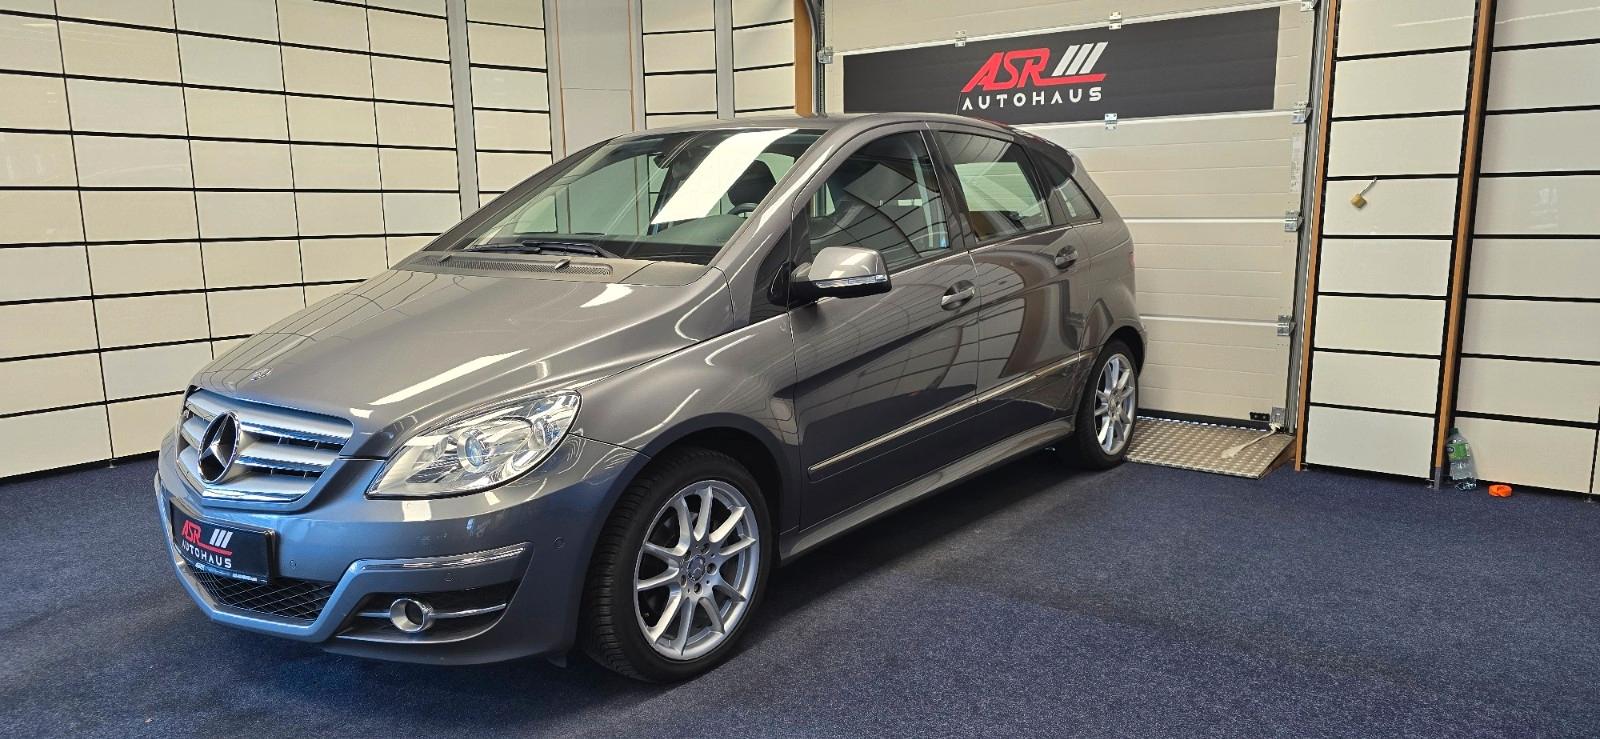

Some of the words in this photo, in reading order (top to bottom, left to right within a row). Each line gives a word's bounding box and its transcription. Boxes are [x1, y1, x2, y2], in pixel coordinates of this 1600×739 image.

[961, 48, 1051, 92] ASR
[962, 87, 1102, 111] AUTOHAUS
[182, 539, 232, 569] AUTOHAUS
